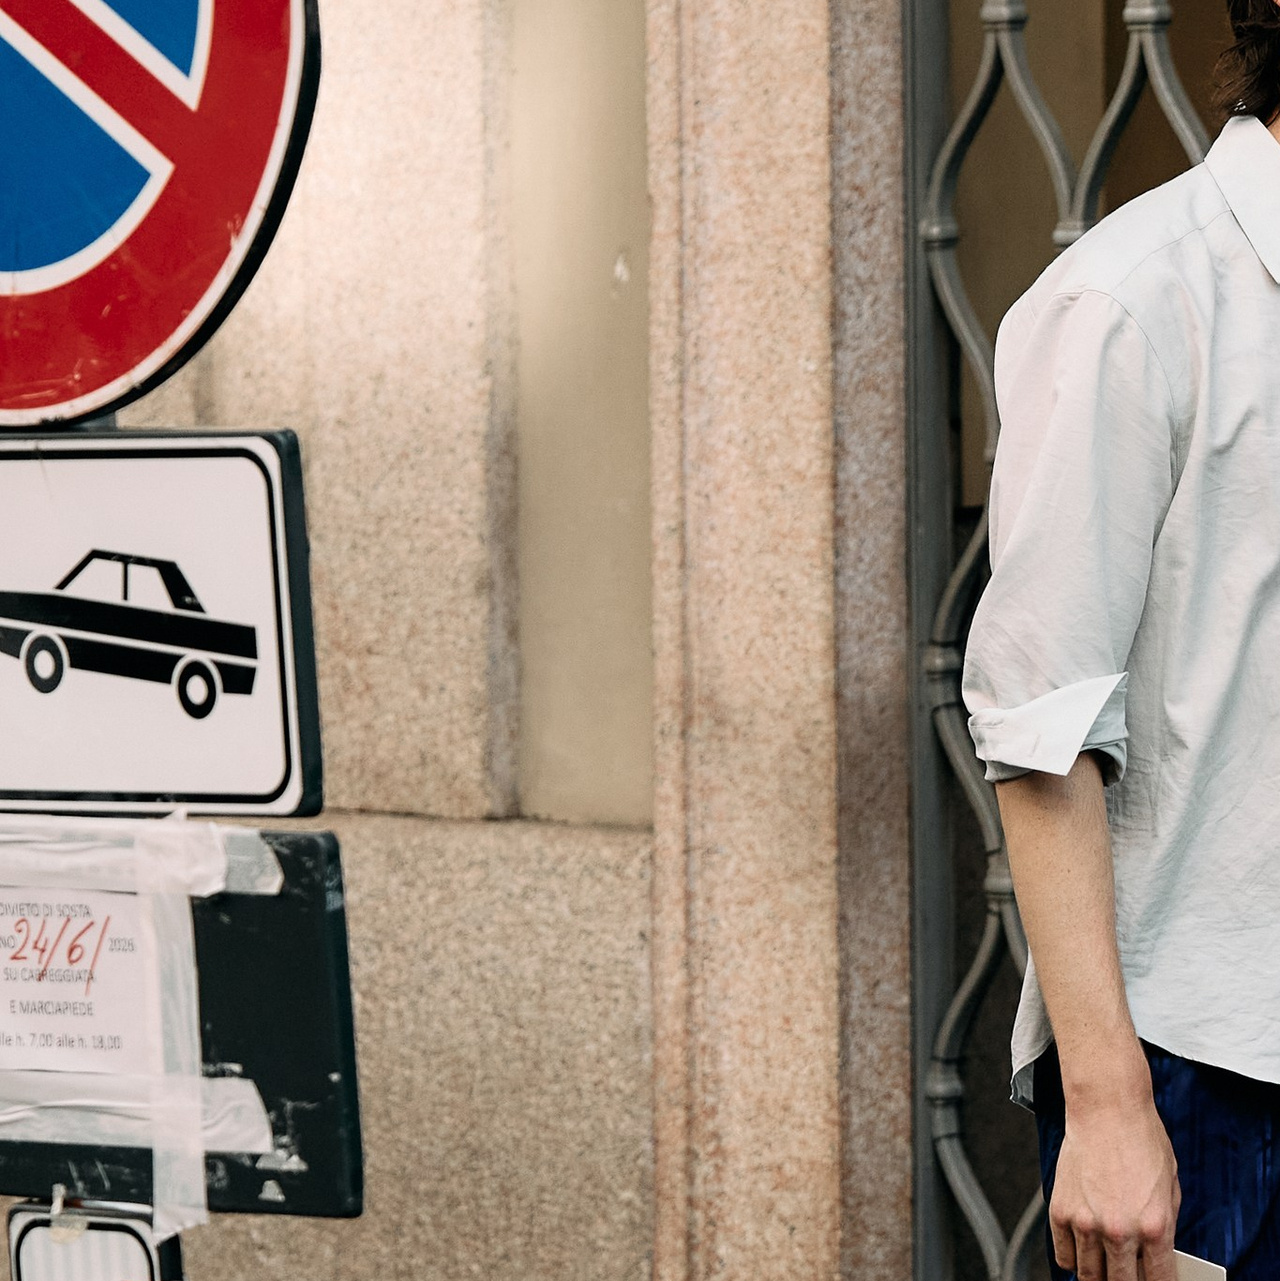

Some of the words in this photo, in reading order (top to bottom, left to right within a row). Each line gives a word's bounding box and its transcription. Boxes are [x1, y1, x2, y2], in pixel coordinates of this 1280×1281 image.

[43, 903, 53, 917] DI
[57, 904, 93, 918] SOSTA
[3, 968, 17, 981] SU
[10, 999, 16, 1014] E
[19, 1000, 94, 1016] MARCIAPIEDE
[56, 1034, 75, 1048] alle
